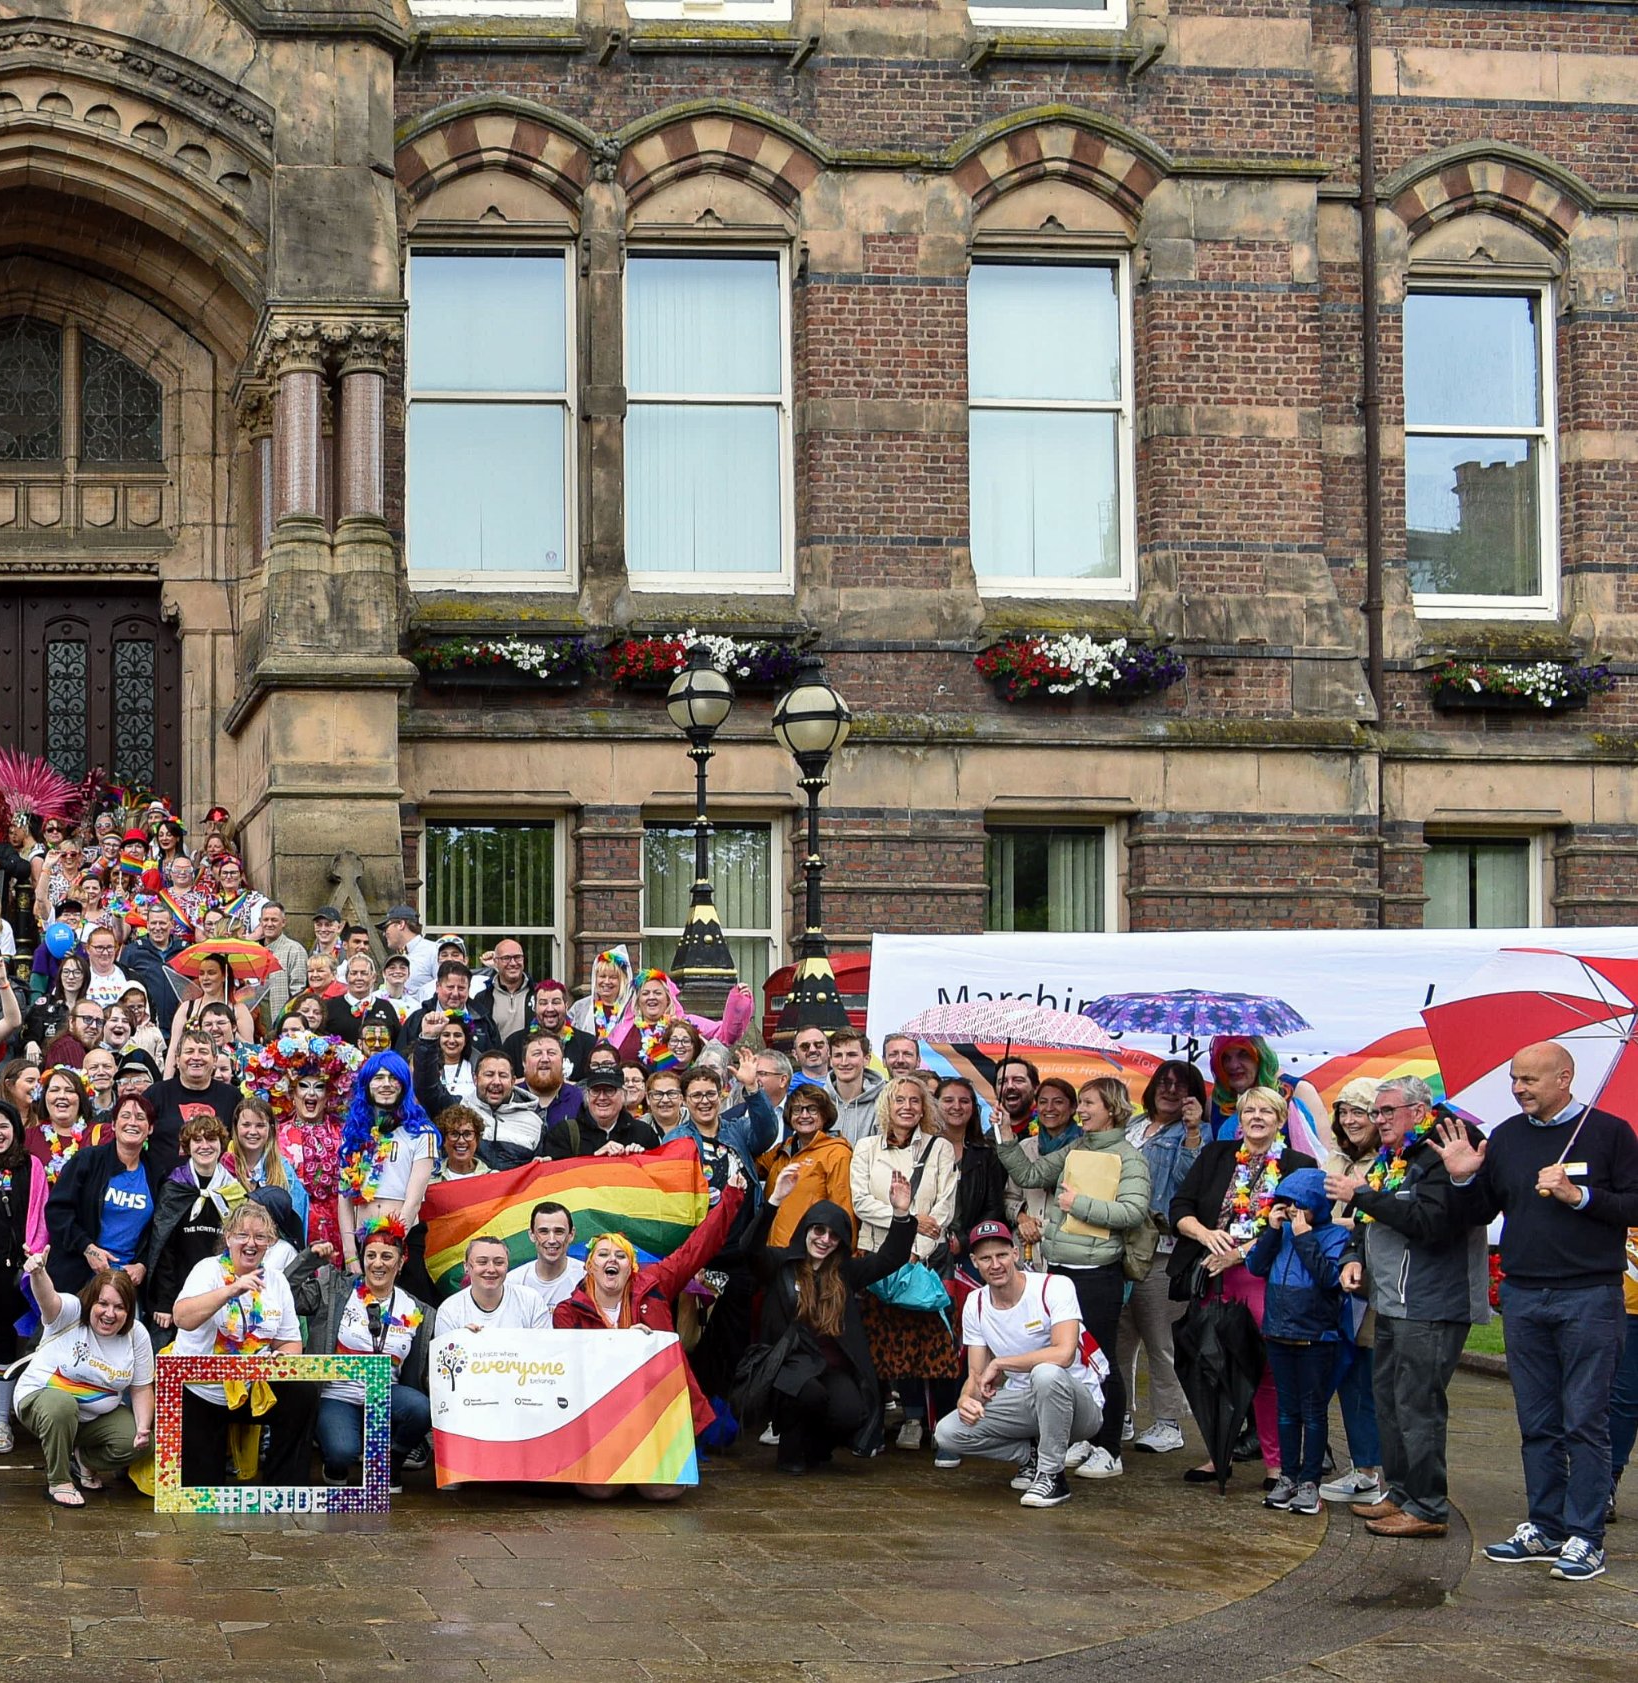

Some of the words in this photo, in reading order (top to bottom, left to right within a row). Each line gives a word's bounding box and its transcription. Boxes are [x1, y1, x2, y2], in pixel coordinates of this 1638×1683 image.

[104, 1187, 147, 1210] NHS
[183, 1226, 195, 1234] THE
[196, 1225, 216, 1234] NORTH
[479, 1351, 498, 1359] place
[471, 1360, 565, 1387] everyone
[215, 1486, 328, 1514] #PRIDE
